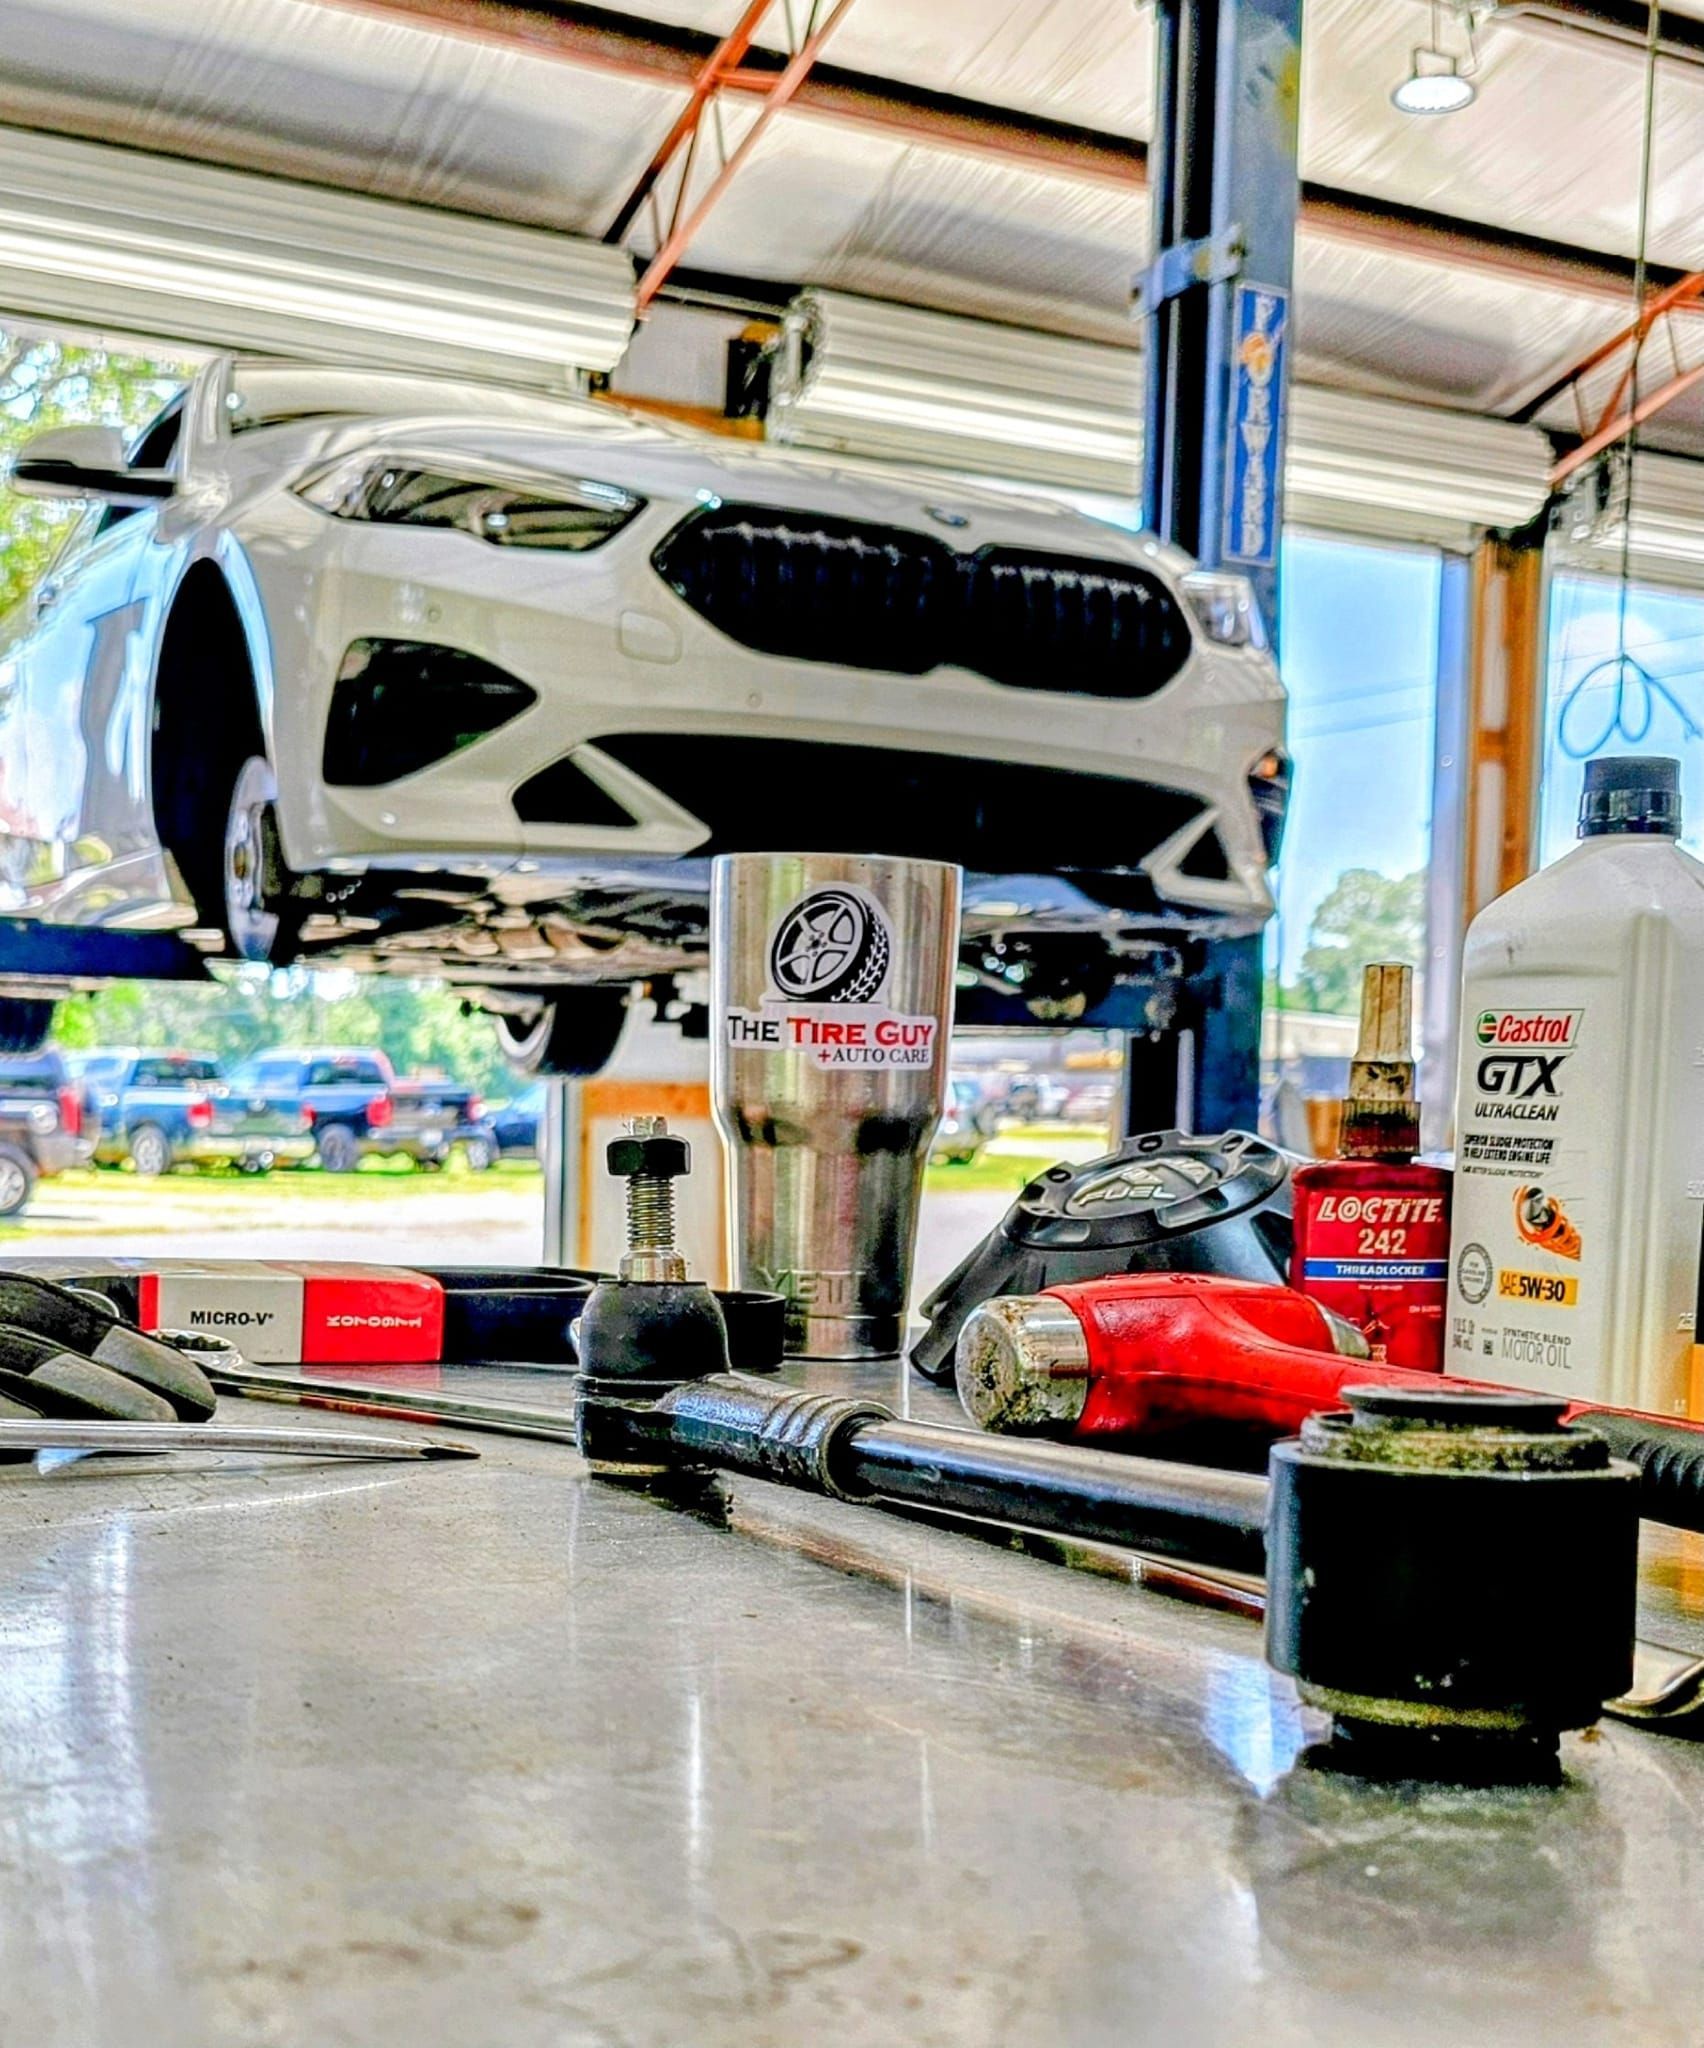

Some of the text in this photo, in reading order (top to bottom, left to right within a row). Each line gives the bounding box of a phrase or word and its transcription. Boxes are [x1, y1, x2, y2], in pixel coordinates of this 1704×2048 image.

[728, 1015, 933, 1046] THE TIRE GUY
[1498, 1014, 1572, 1043] Castrol
[889, 1049, 929, 1063] CARE
[1477, 1055, 1567, 1098] GTX
[1474, 1102, 1560, 1121] ULTRACLEAN
[1078, 1185, 1177, 1207] FUEL
[1316, 1196, 1443, 1224] LOCTITE
[1358, 1228, 1407, 1255] 242
[1336, 1264, 1427, 1276] THREADLOCKER
[1500, 1272, 1518, 1296] SAE
[1519, 1276, 1566, 1302] 5W-30
[1502, 1327, 1541, 1340] SYNTHETIC
[1543, 1334, 1572, 1346] BLEND
[1502, 1338, 1543, 1365] MOTOR
[1547, 1344, 1572, 1369] OIL
